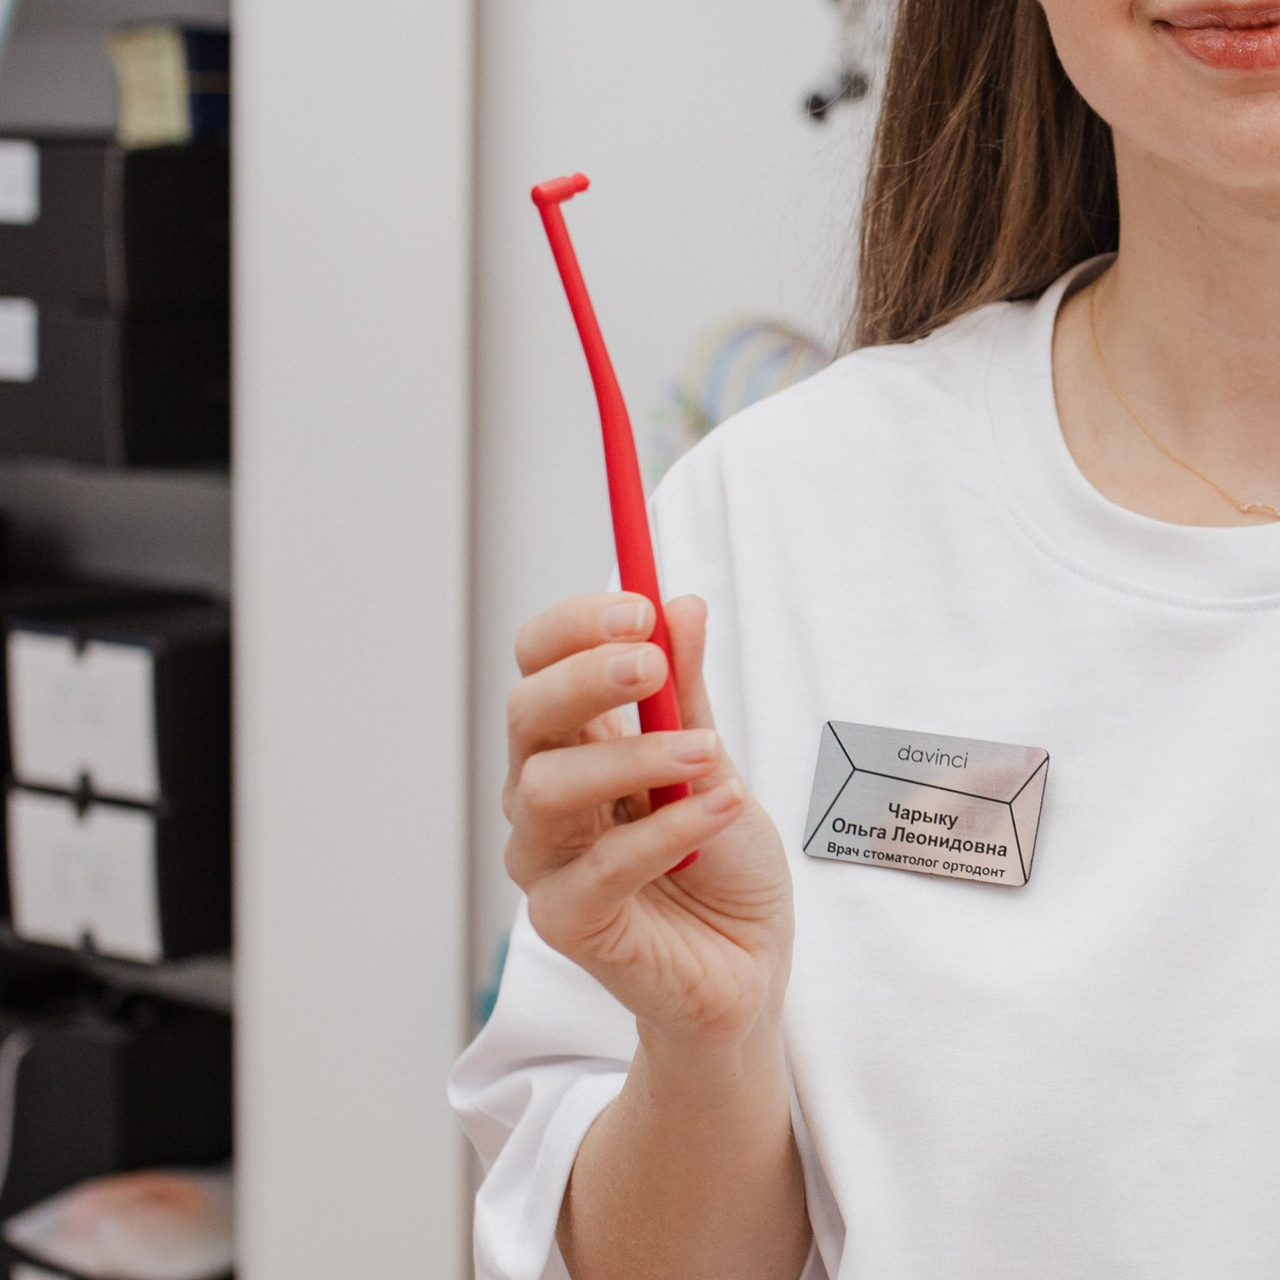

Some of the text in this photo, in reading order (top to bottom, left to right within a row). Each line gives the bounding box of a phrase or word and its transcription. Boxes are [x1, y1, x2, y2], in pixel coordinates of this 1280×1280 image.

[897, 744, 969, 769] davinci
[888, 801, 959, 831] Чарыку
[831, 817, 1008, 858] Ольга Леонидовна
[826, 840, 1007, 879] Врач стоматолог ортодонт
